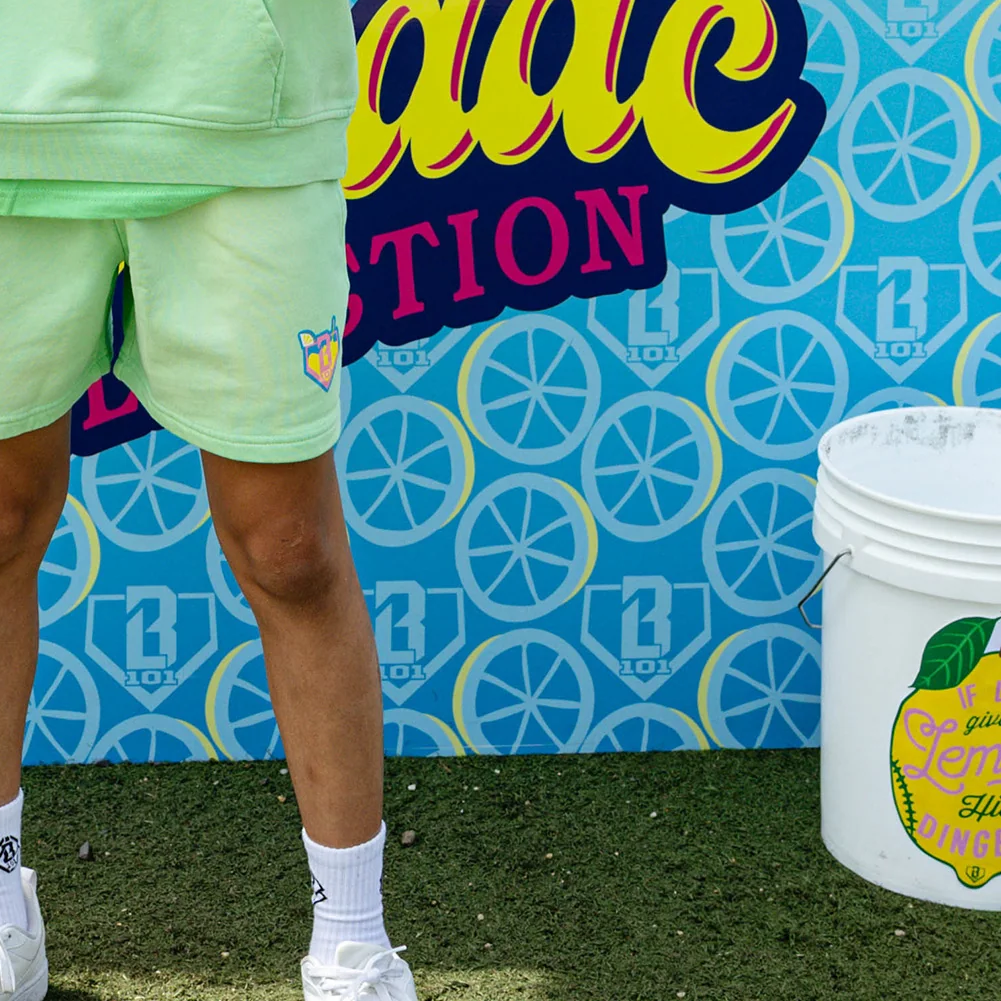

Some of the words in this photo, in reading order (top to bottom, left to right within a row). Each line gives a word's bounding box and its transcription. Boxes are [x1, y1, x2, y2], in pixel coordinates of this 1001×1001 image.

[883, 21, 939, 39] 101
[376, 349, 430, 367] 101
[626, 345, 680, 362] 101
[874, 341, 929, 359] 101
[618, 658, 673, 676] 101
[124, 669, 178, 687] 101
[956, 683, 977, 710] IF
[963, 710, 1001, 736] giv
[902, 708, 1001, 795] Lem
[958, 793, 1001, 823] Hi
